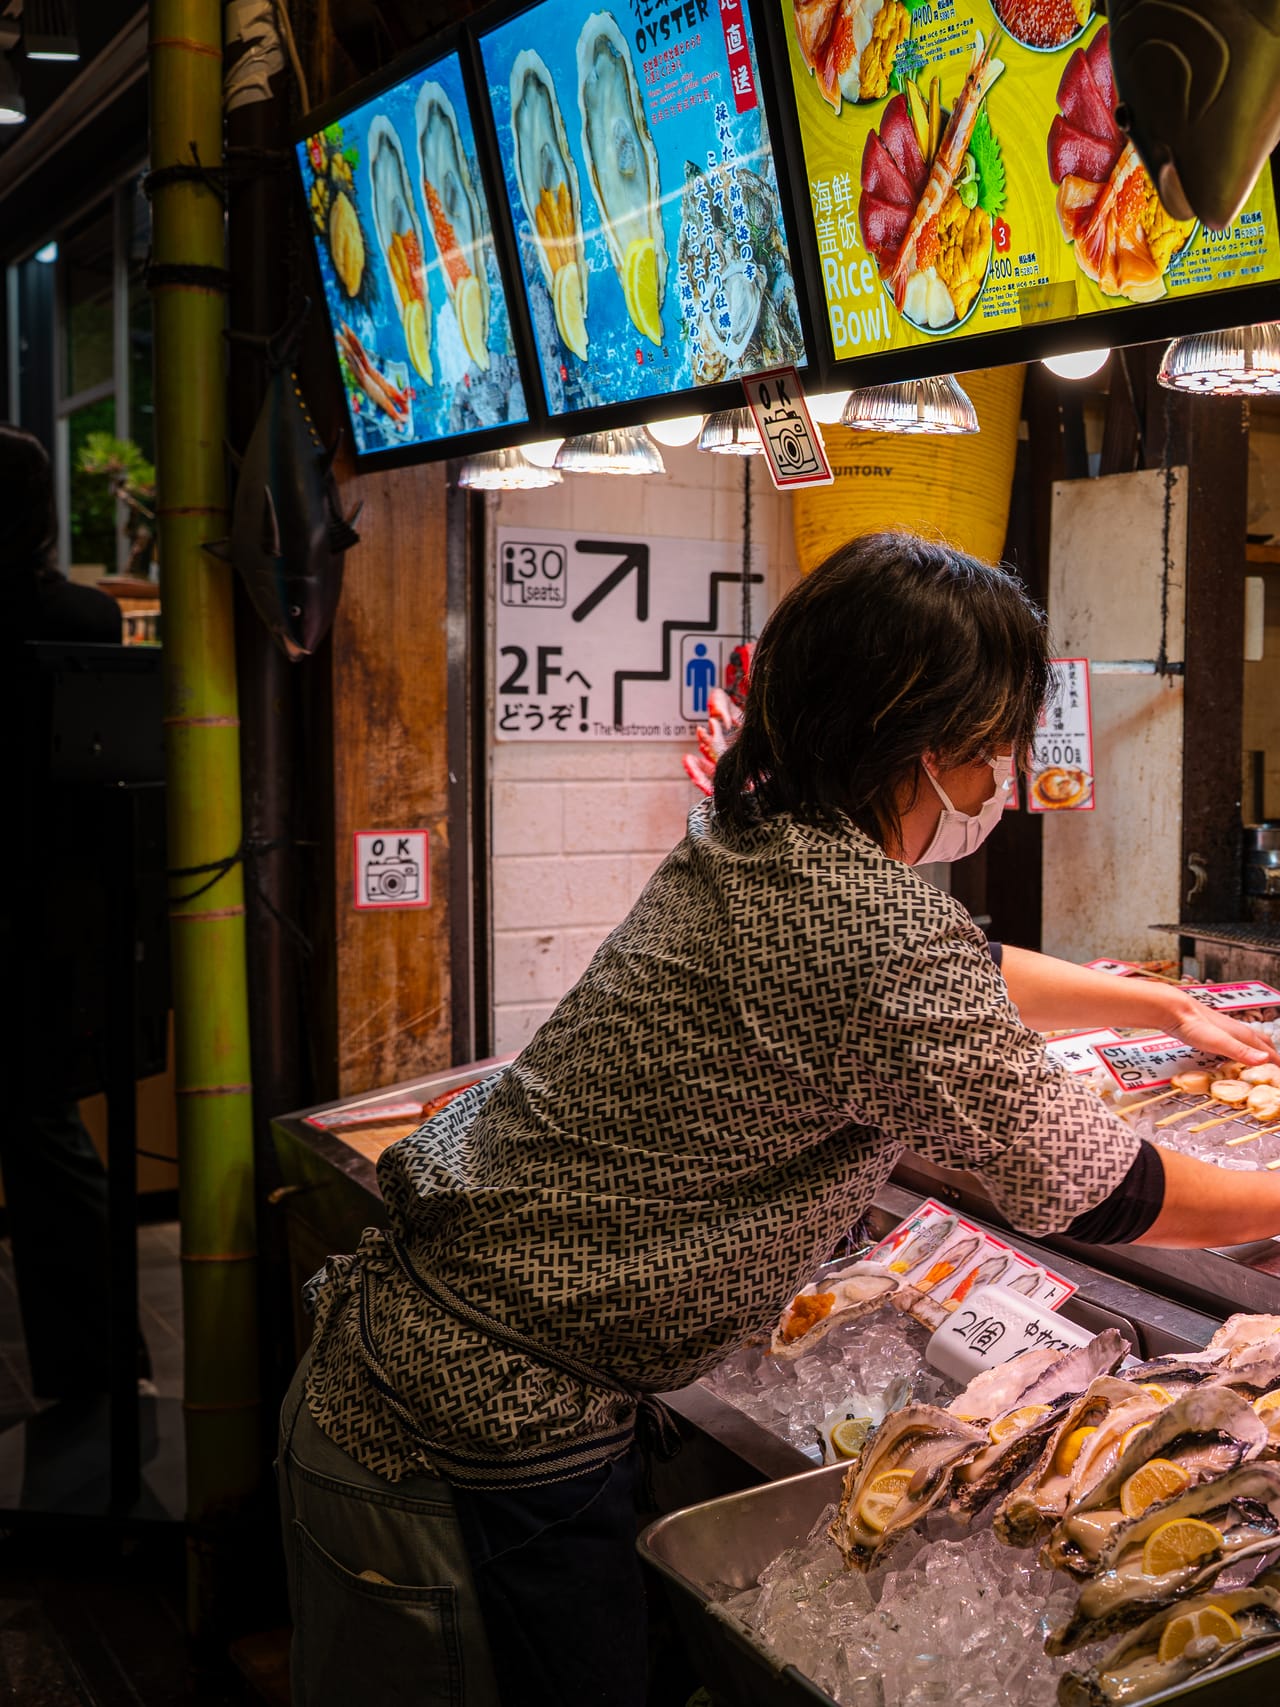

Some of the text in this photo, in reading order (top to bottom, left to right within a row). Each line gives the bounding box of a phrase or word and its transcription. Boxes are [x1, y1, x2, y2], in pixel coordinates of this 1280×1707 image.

[636, 0, 709, 54] OYSTER
[998, 227, 1006, 246] 3
[824, 252, 874, 300] Rice
[830, 293, 891, 347] Bowl
[831, 465, 893, 477] UNTORY
[518, 547, 563, 580] 30
[500, 646, 592, 695] 2Fへ
[500, 696, 589, 733] どうぞ!
[594, 722, 612, 735] The
[663, 722, 672, 735] is
[674, 726, 686, 735] on
[1103, 1047, 1143, 1081] 550
[952, 1311, 1007, 1357] 2個
